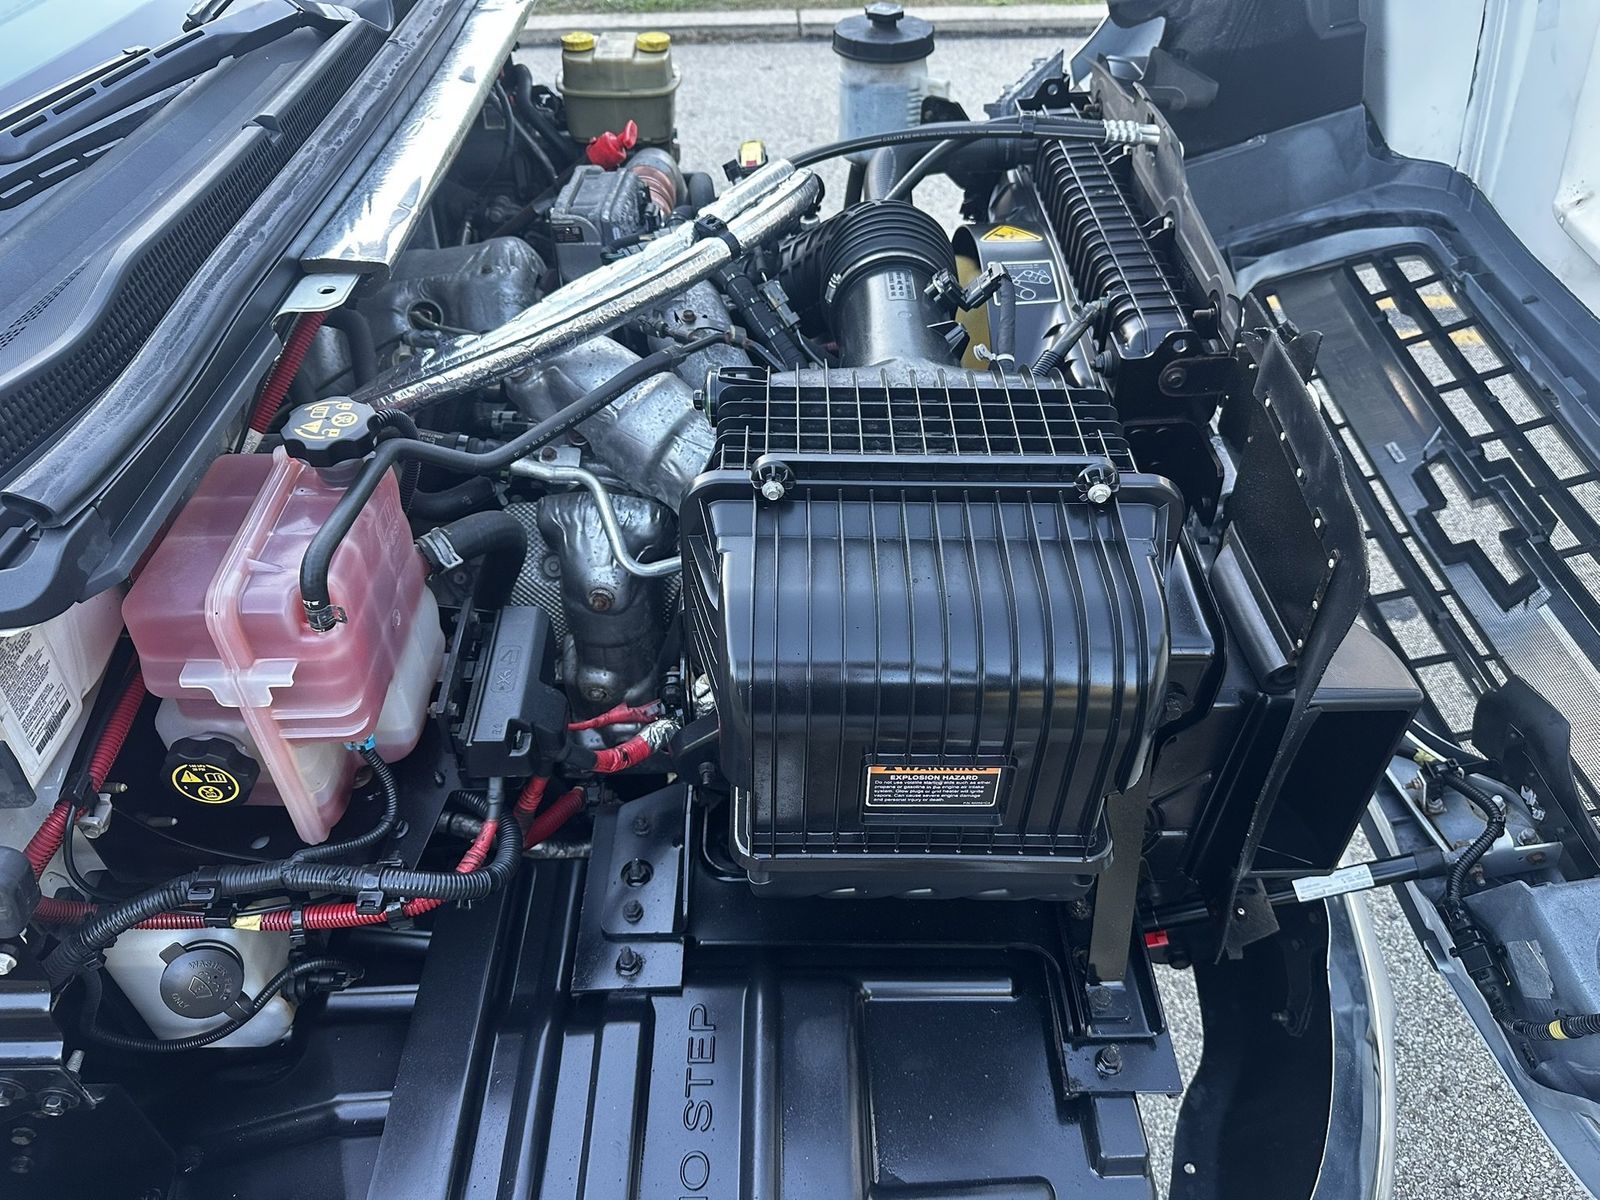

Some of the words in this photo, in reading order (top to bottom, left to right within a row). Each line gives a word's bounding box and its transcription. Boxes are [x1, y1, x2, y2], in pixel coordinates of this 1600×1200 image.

[188, 960, 228, 976] WASHER
[683, 1003, 716, 1132] STEP
[679, 1150, 711, 1200] O
